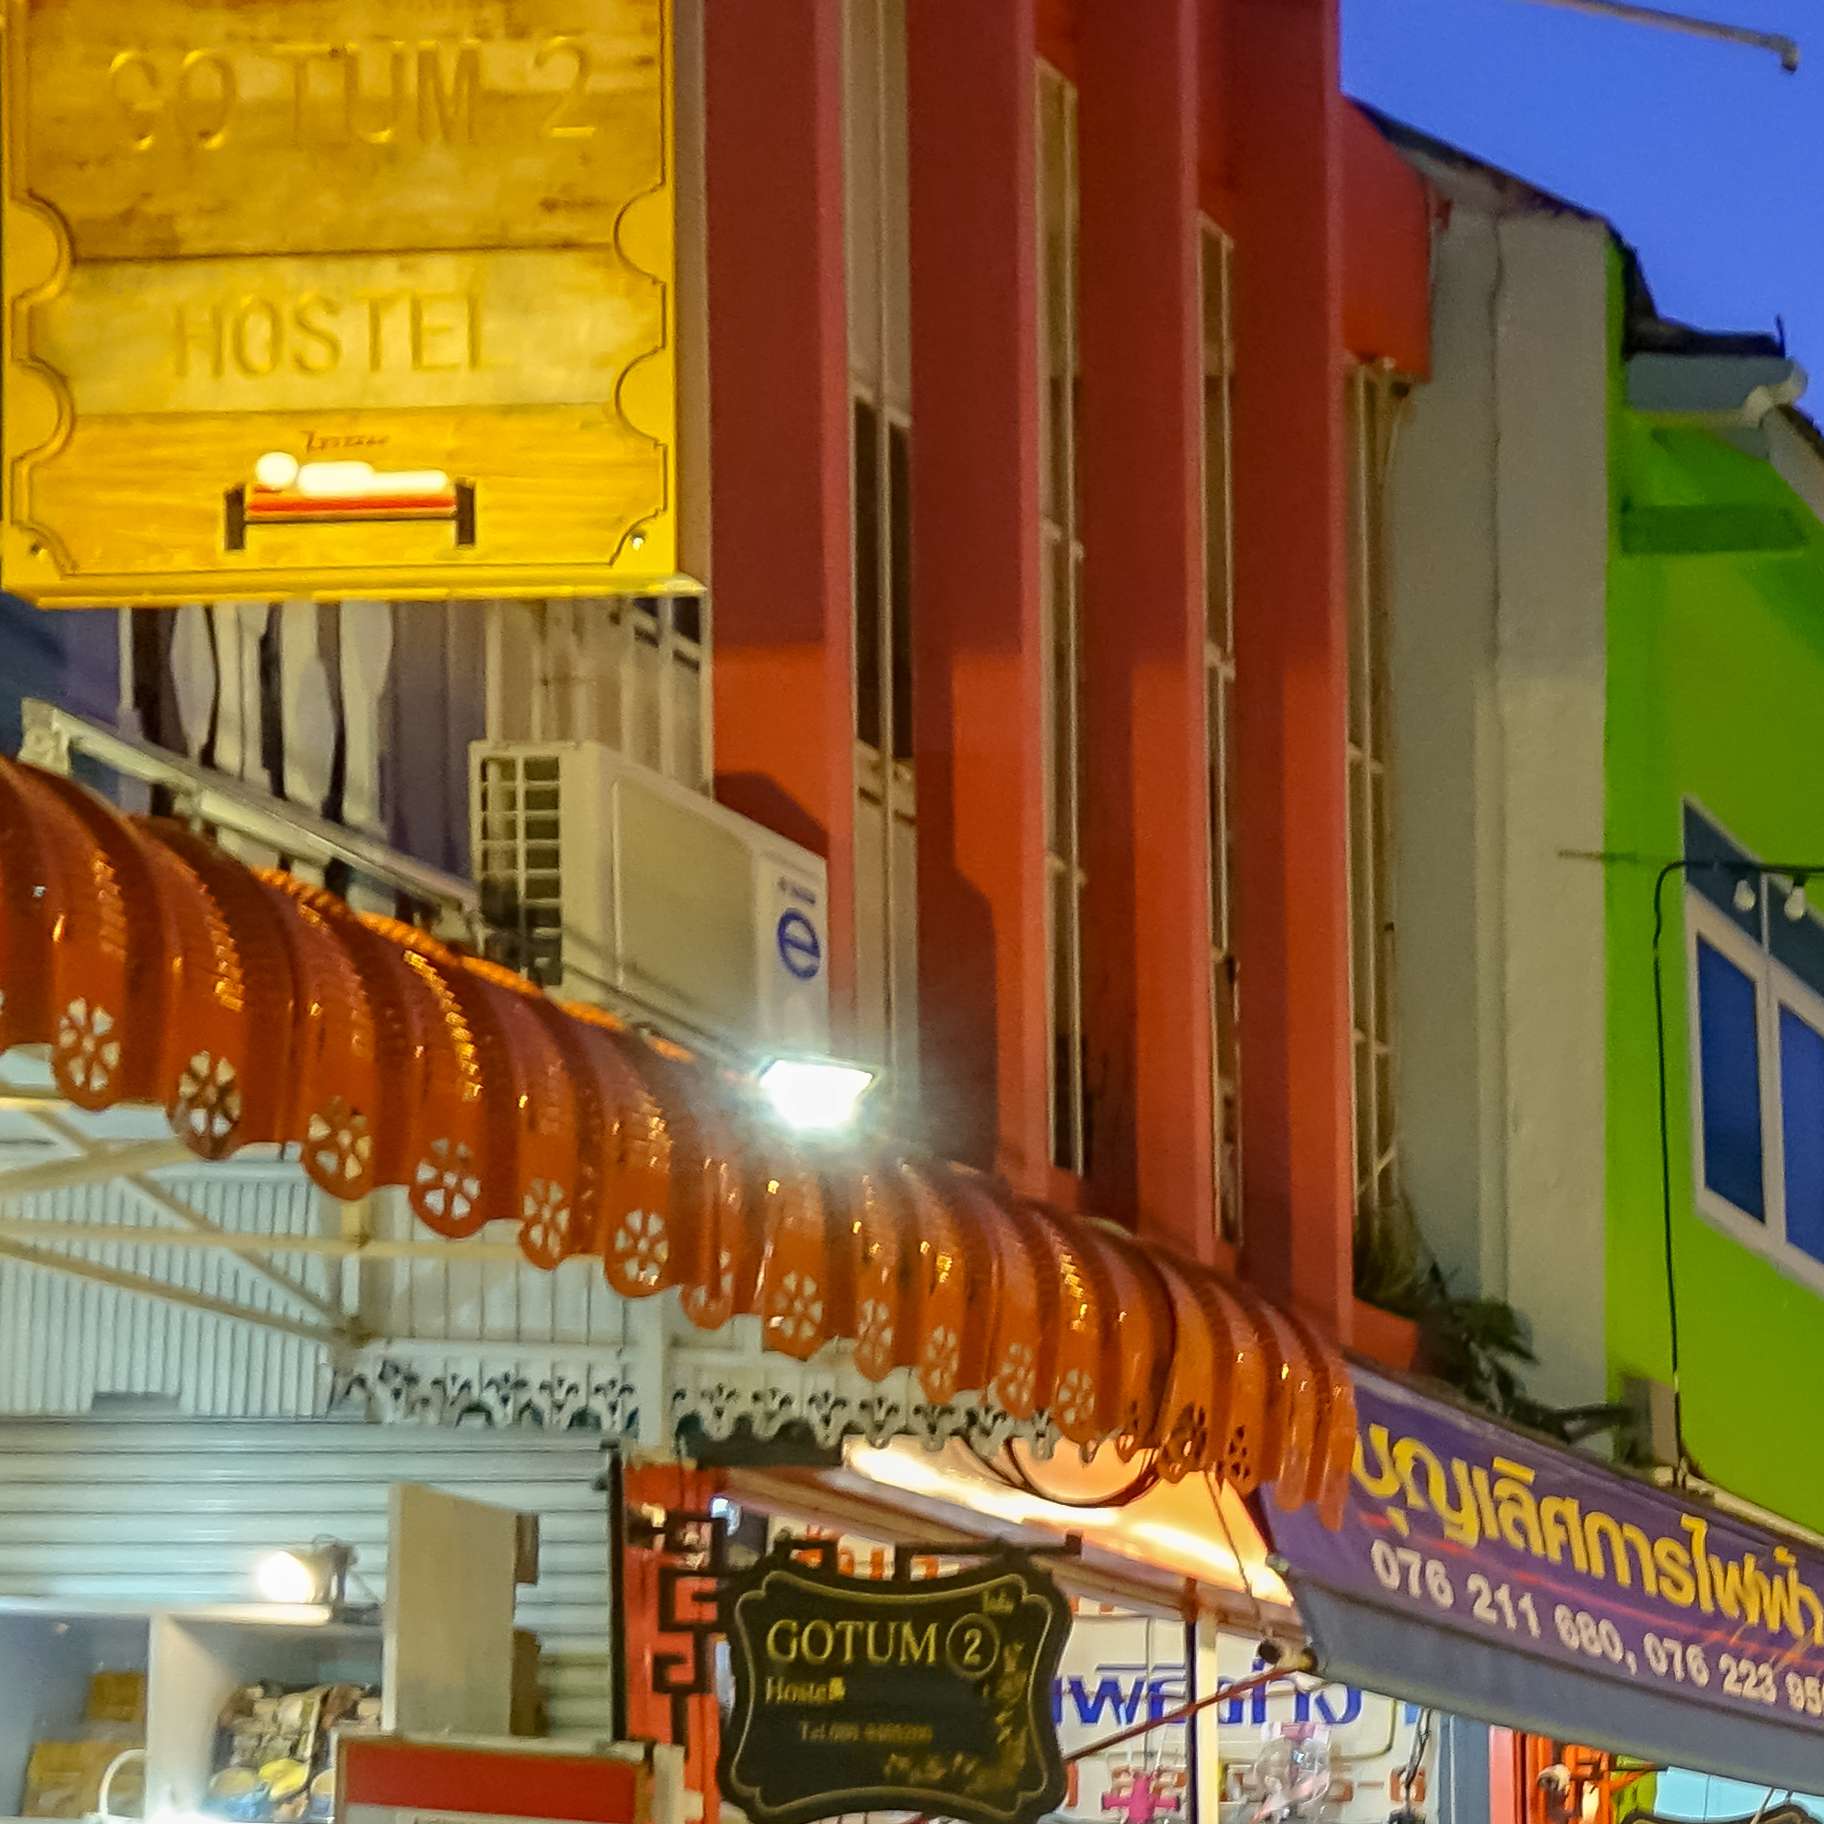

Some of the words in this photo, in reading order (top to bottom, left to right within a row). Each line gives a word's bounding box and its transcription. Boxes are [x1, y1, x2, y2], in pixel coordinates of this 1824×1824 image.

[531, 36, 598, 139] 2
[173, 290, 498, 378] HOSTEL
[766, 1618, 939, 1666] GOTUM
[962, 1627, 983, 1668] 2
[1371, 1539, 1455, 1609] 076
[1466, 1572, 1542, 1640] 211
[1643, 1631, 1711, 1688] 076
